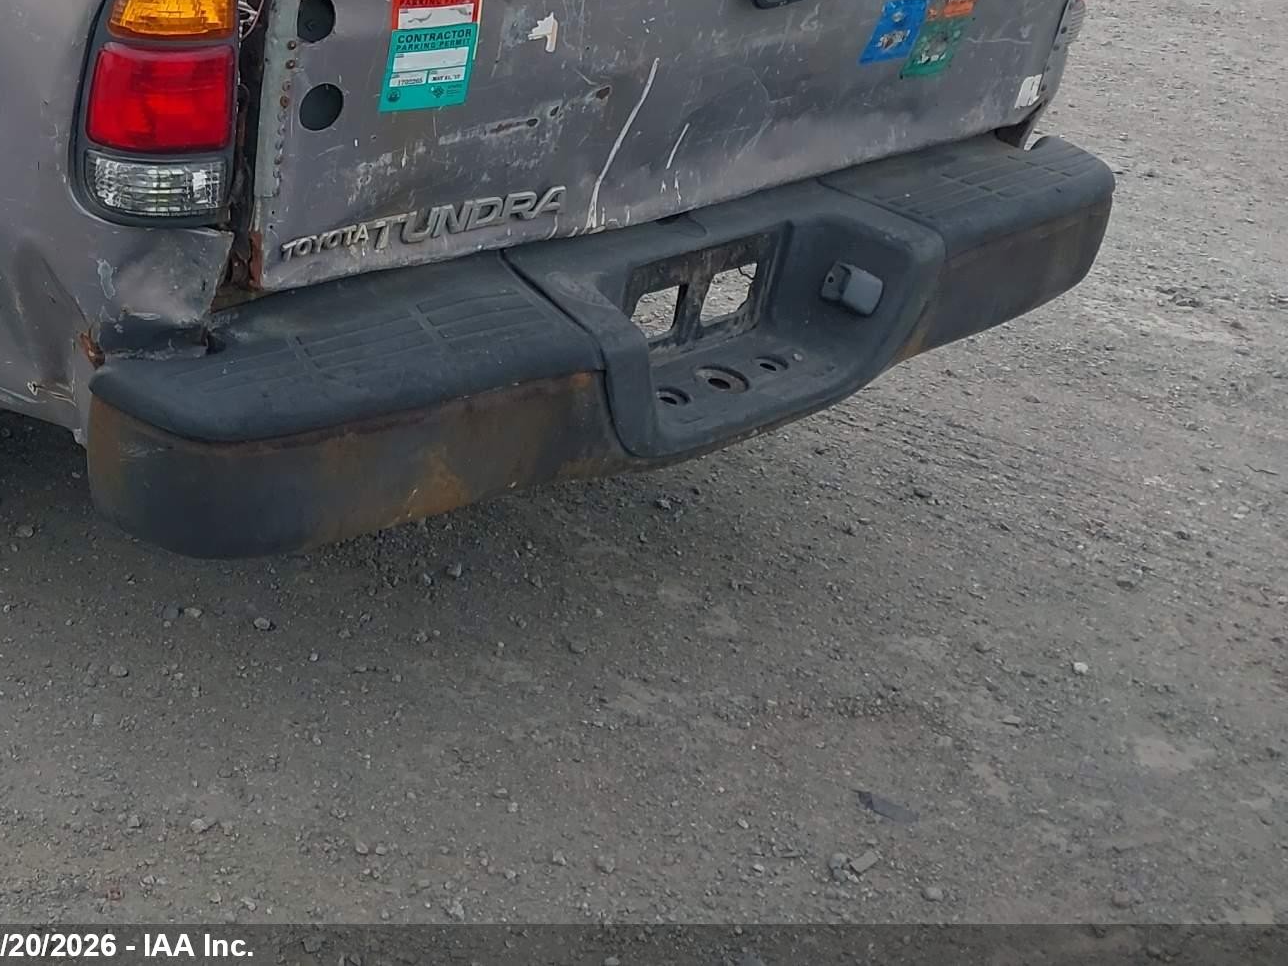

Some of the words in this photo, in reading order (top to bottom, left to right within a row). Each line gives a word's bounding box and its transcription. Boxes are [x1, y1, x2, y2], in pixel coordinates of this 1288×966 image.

[397, 28, 473, 44] CONTRACTOR
[395, 41, 436, 52] PARKING
[439, 37, 471, 48] PERMIT
[281, 223, 369, 262] TOYOTA
[366, 185, 567, 251] TUNDRA
